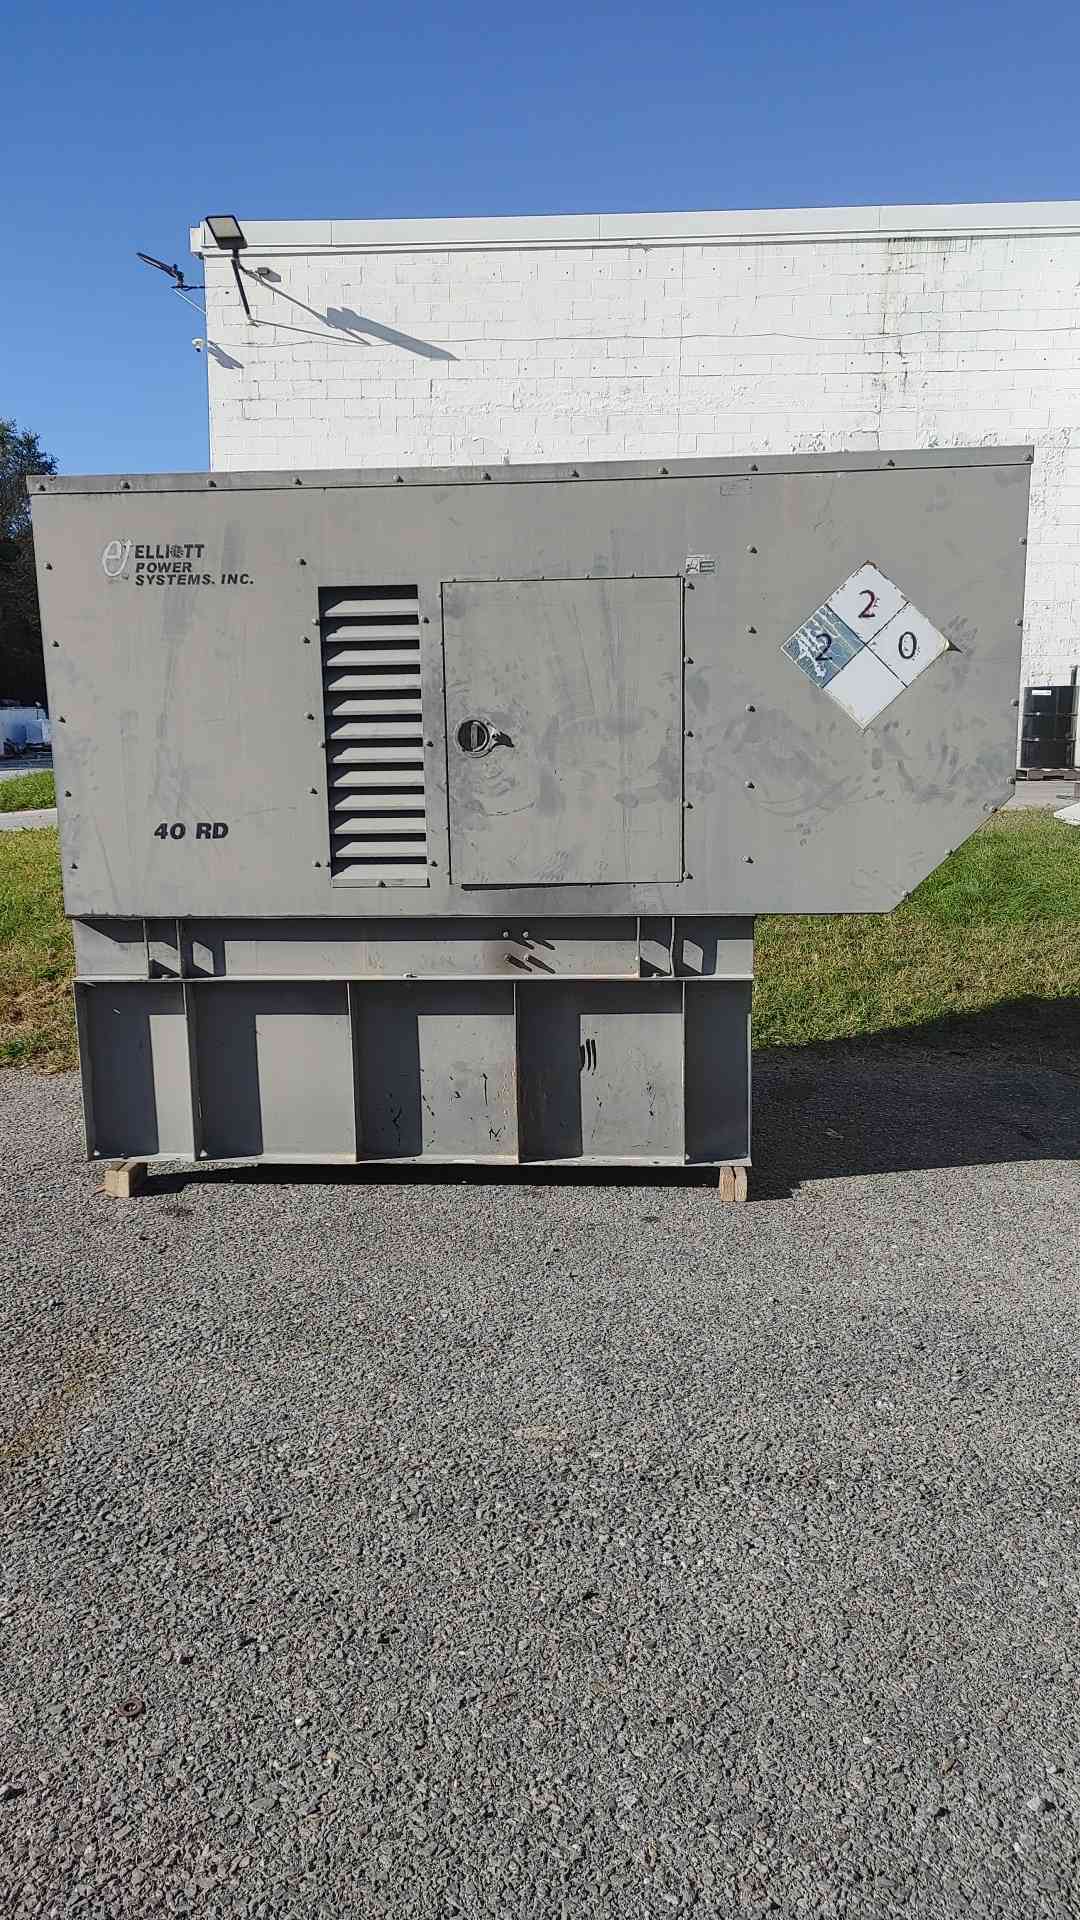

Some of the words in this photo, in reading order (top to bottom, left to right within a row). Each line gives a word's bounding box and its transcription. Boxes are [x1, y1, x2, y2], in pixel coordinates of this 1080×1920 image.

[134, 543, 205, 559] ELLIOTT
[135, 562, 192, 573] POWER
[220, 573, 255, 585] INC.
[858, 589, 876, 619] 2
[815, 633, 833, 662] 2
[898, 631, 918, 660] 0
[153, 822, 187, 841] 40
[195, 822, 230, 840] RD
